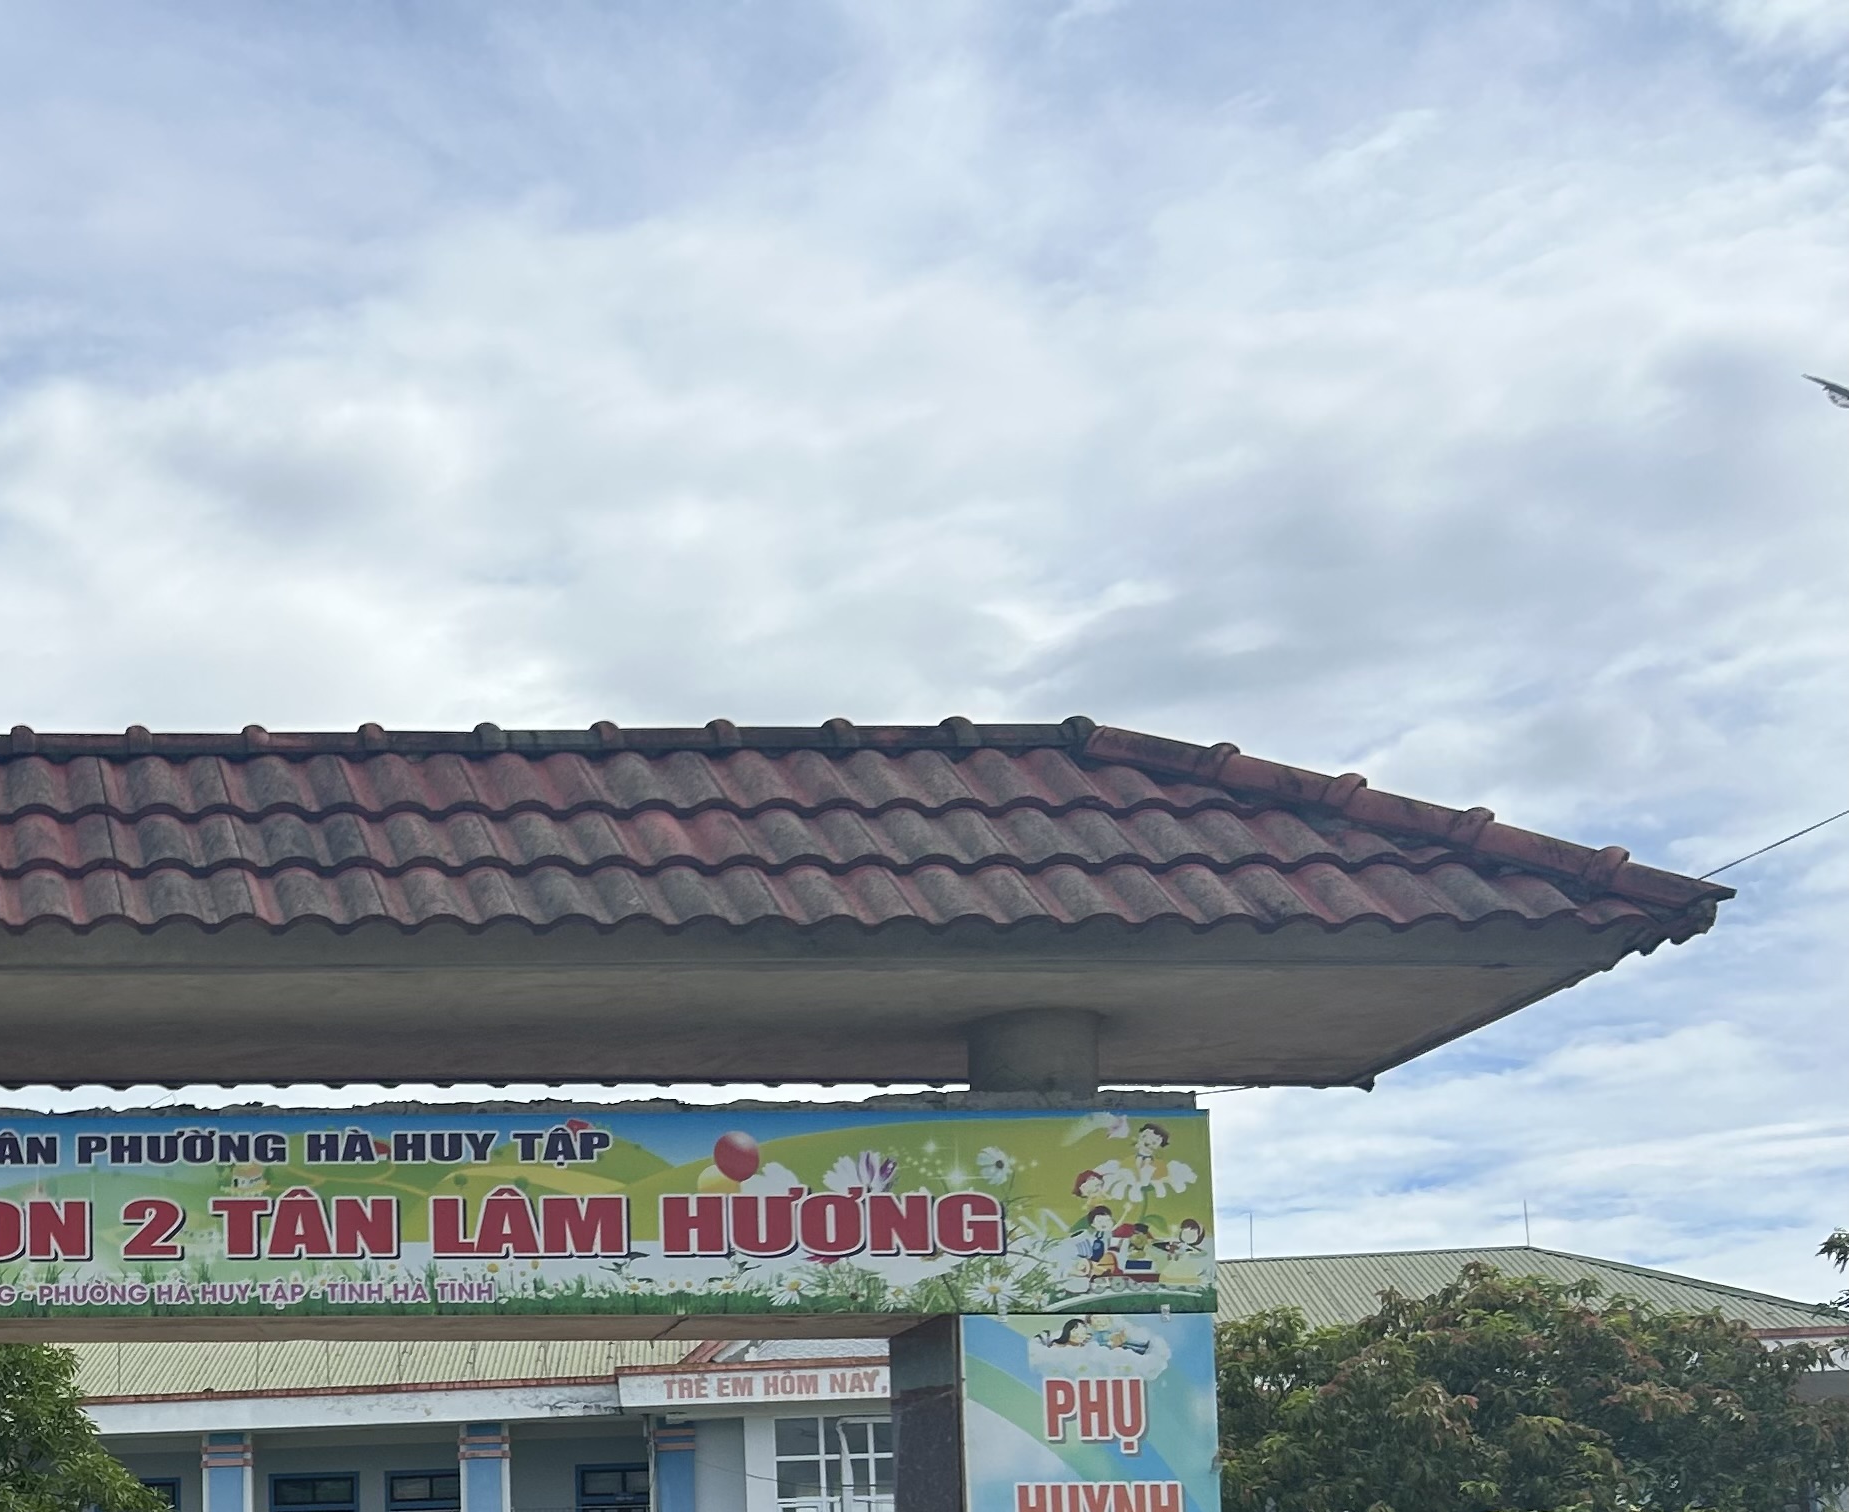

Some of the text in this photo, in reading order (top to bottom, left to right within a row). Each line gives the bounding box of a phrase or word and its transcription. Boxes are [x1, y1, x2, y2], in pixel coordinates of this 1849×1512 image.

[77, 1128, 287, 1164] PHƯỜNG
[306, 1128, 376, 1163] HÀ
[393, 1132, 497, 1163] HUY
[512, 1127, 611, 1167] TẬP
[123, 1199, 181, 1257] 2
[213, 1190, 394, 1256] TÂN
[433, 1189, 625, 1255] LÂM
[663, 1188, 999, 1254] HƯƠNG
[38, 1282, 147, 1304] PHƯỜNG
[157, 1280, 191, 1303] HÀ
[200, 1283, 251, 1303] HUY
[259, 1281, 304, 1309] TẬP
[392, 1278, 429, 1302] HÀ
[716, 1376, 754, 1397] EM
[763, 1370, 819, 1395] HÔM
[1046, 1380, 1145, 1451] PHỤ
